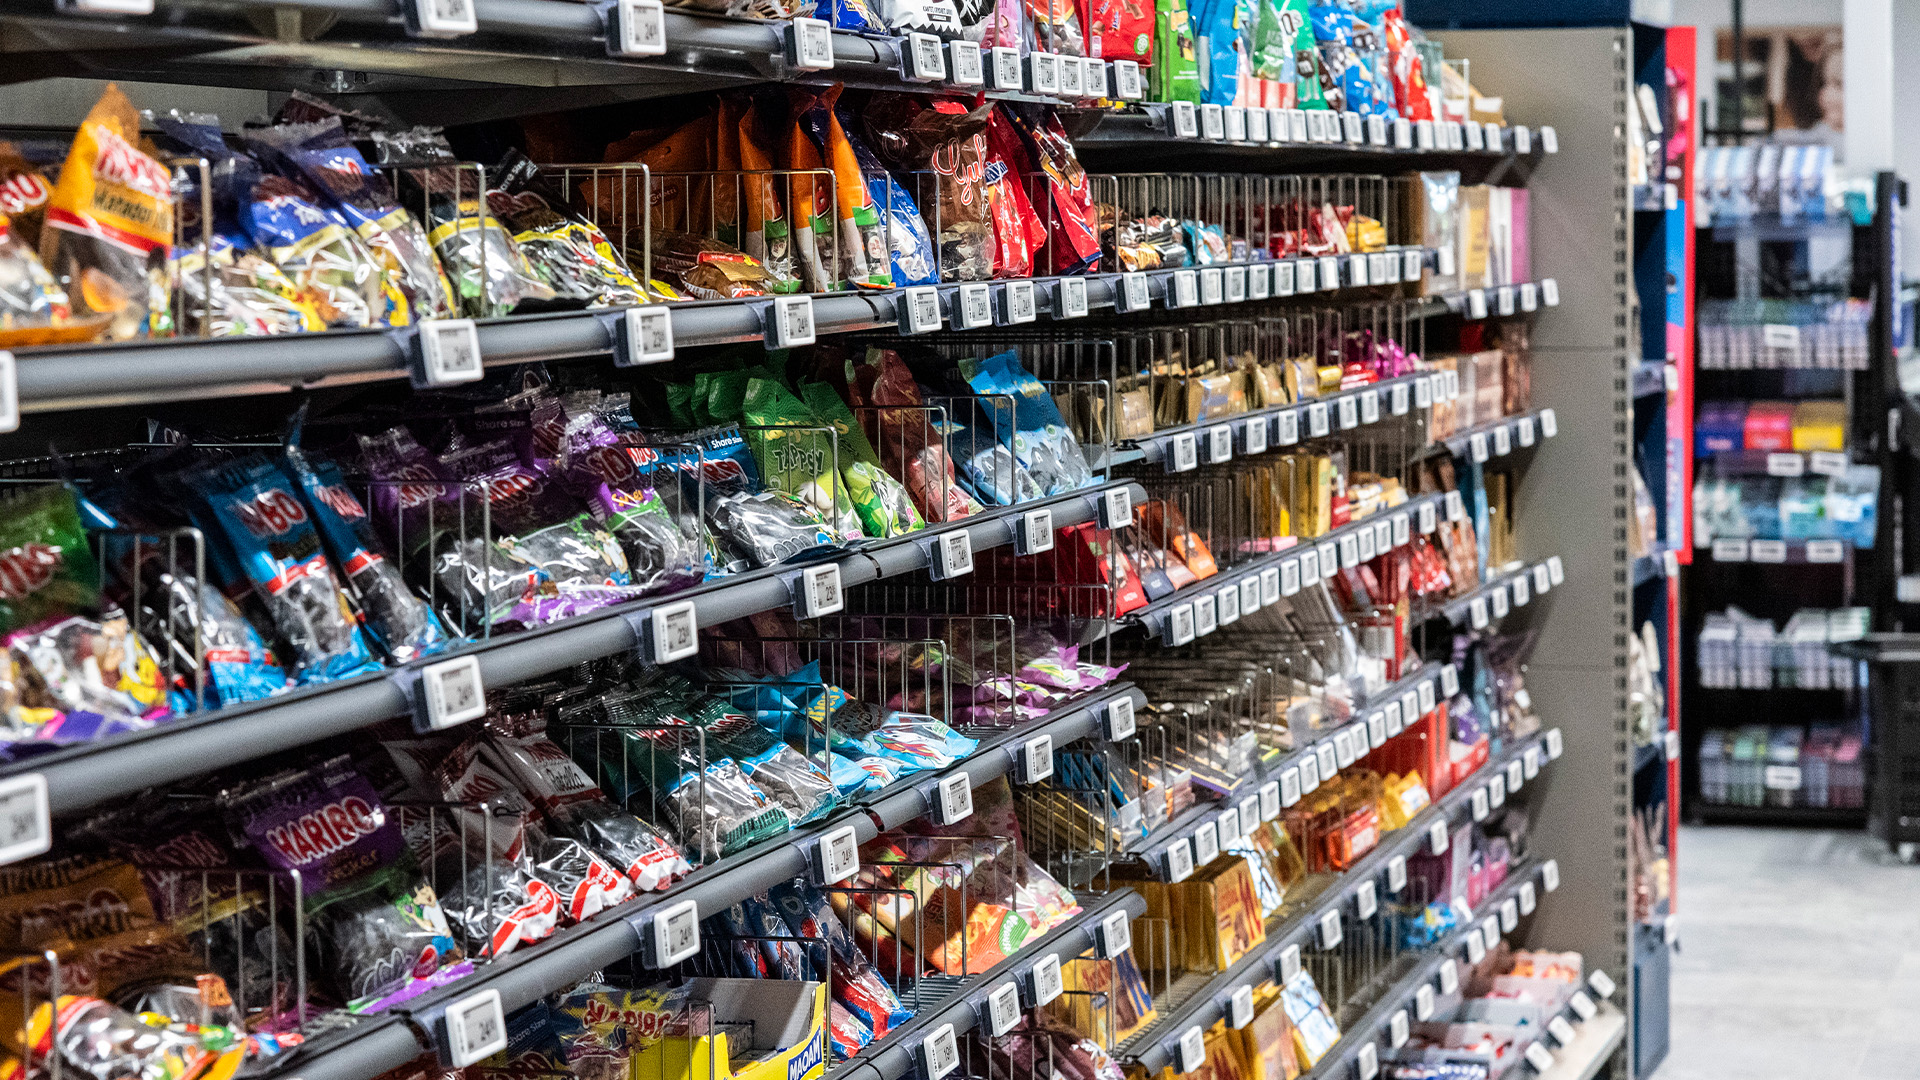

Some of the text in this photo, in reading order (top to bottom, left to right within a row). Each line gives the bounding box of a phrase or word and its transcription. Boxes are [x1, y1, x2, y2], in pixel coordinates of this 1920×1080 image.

[711, 438, 733, 449] Share
[772, 443, 825, 477] TAPPSY
[266, 796, 376, 866] HARIBO
[789, 1035, 820, 1080] MAOAM
